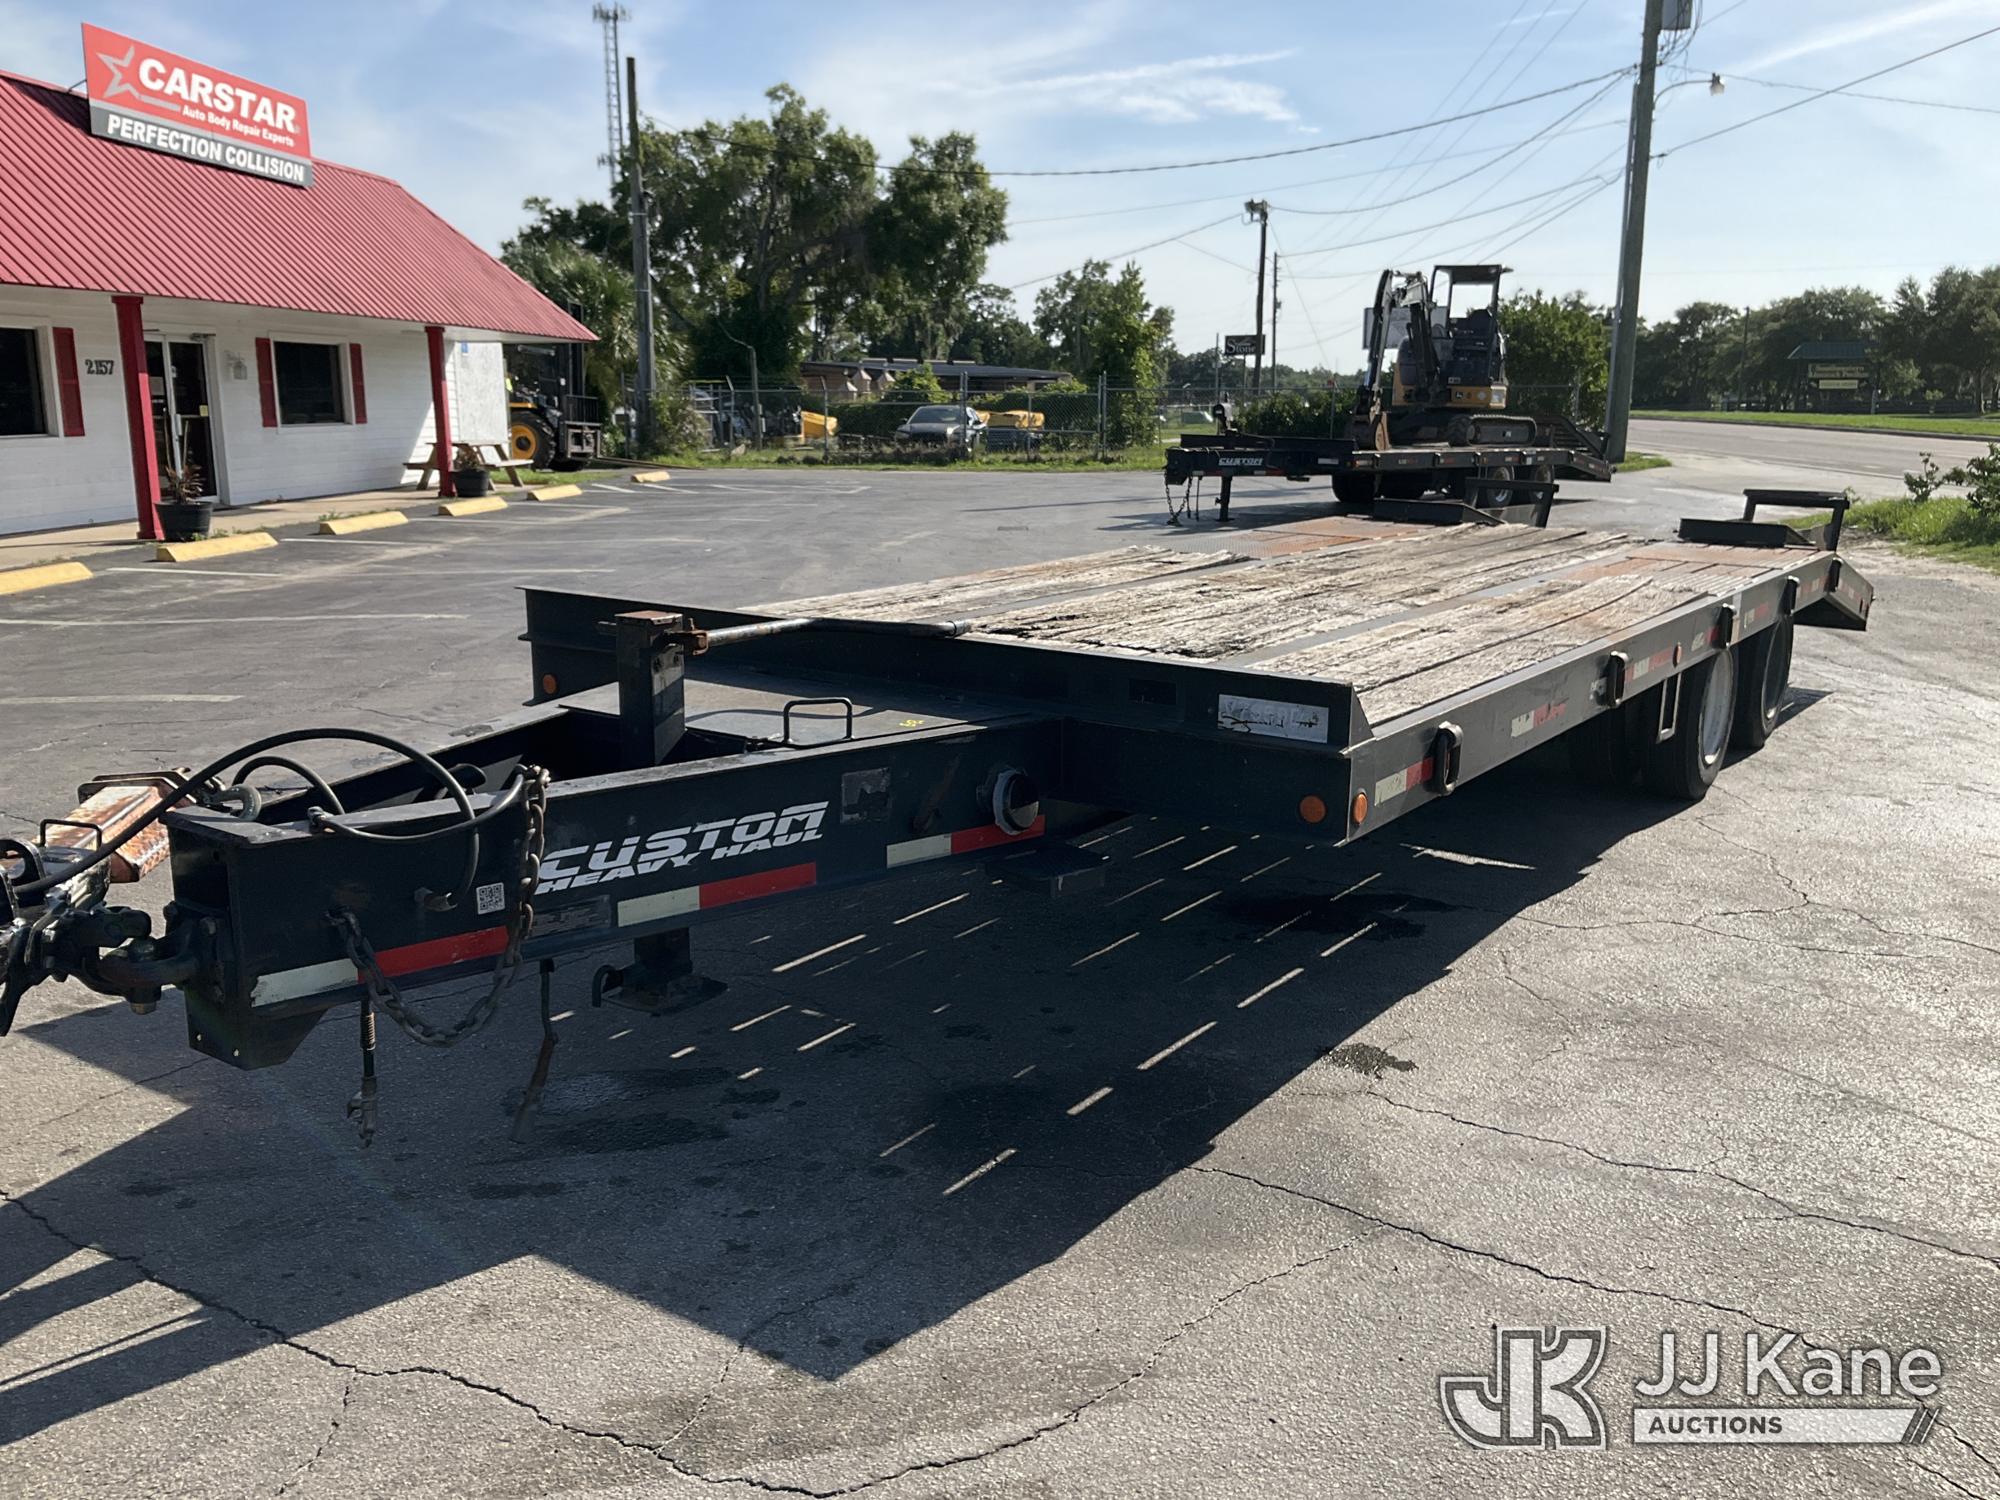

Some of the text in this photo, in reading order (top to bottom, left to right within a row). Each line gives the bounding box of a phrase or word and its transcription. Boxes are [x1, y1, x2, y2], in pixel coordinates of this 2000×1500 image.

[139, 58, 297, 134] CARSTAR
[182, 104, 295, 148] Auto Body Repair Experts
[107, 113, 304, 183] PERFECTION COLLISION
[534, 829, 824, 896] HEAVY HAUL
[538, 801, 829, 880] CUSTOM
